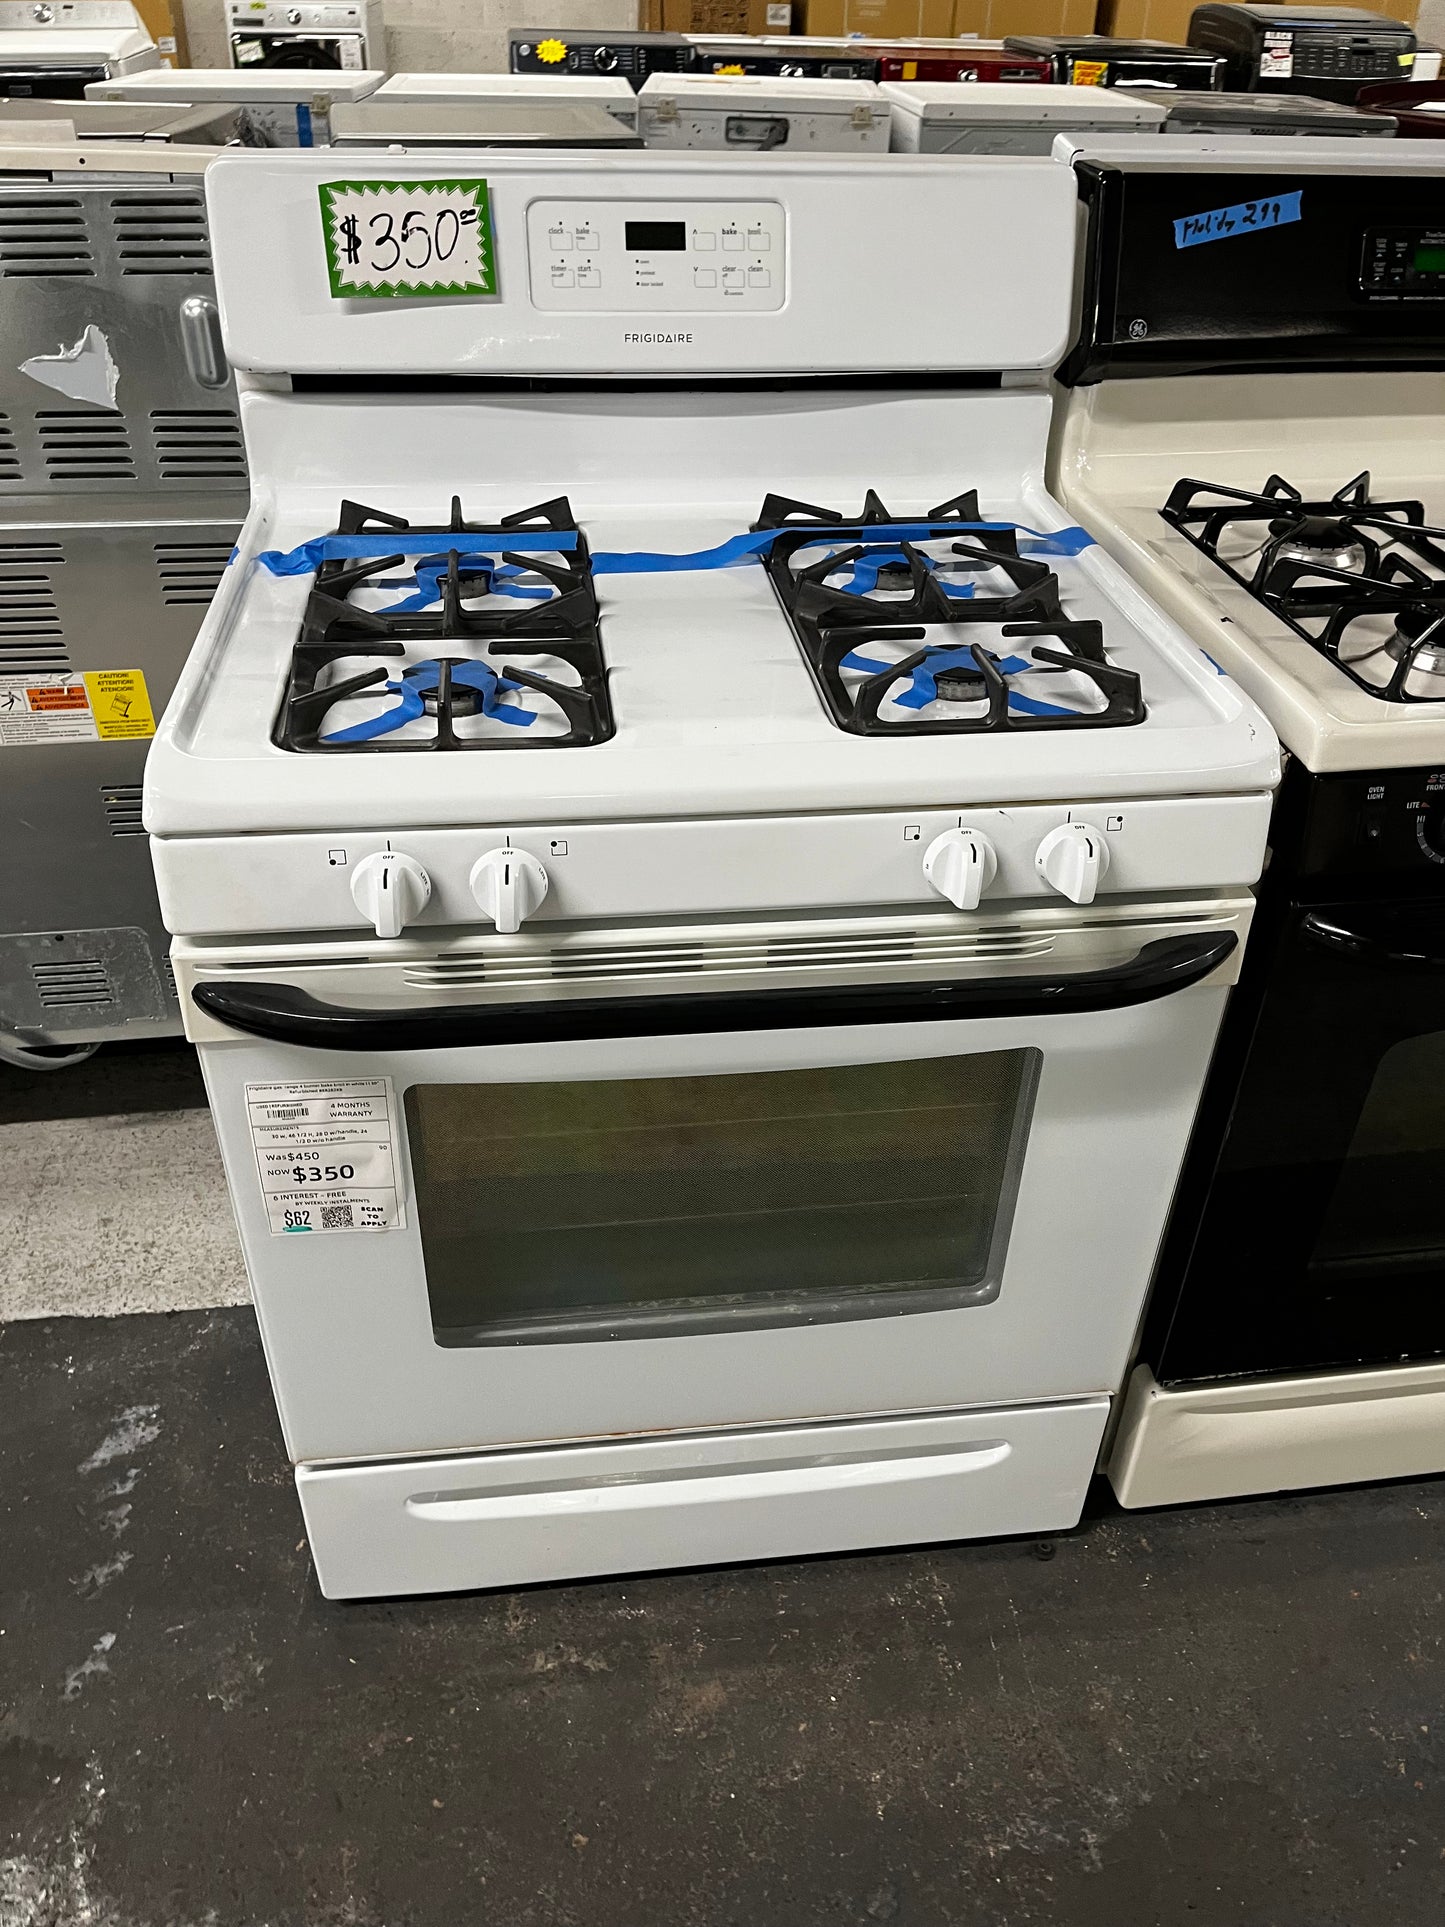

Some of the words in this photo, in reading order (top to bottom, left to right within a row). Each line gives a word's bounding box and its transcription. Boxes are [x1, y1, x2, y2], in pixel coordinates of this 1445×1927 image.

[1242, 202, 1281, 225] 299
[721, 228, 738, 236] bake
[624, 333, 693, 343] FRIGIDAIRE
[1406, 801, 1421, 809] LITE
[329, 1110, 373, 1118] WARRANTY
[287, 1151, 320, 1162] $450
[267, 1168, 290, 1176] NOW
[292, 1164, 355, 1185] $350
[284, 1209, 312, 1228] $62
